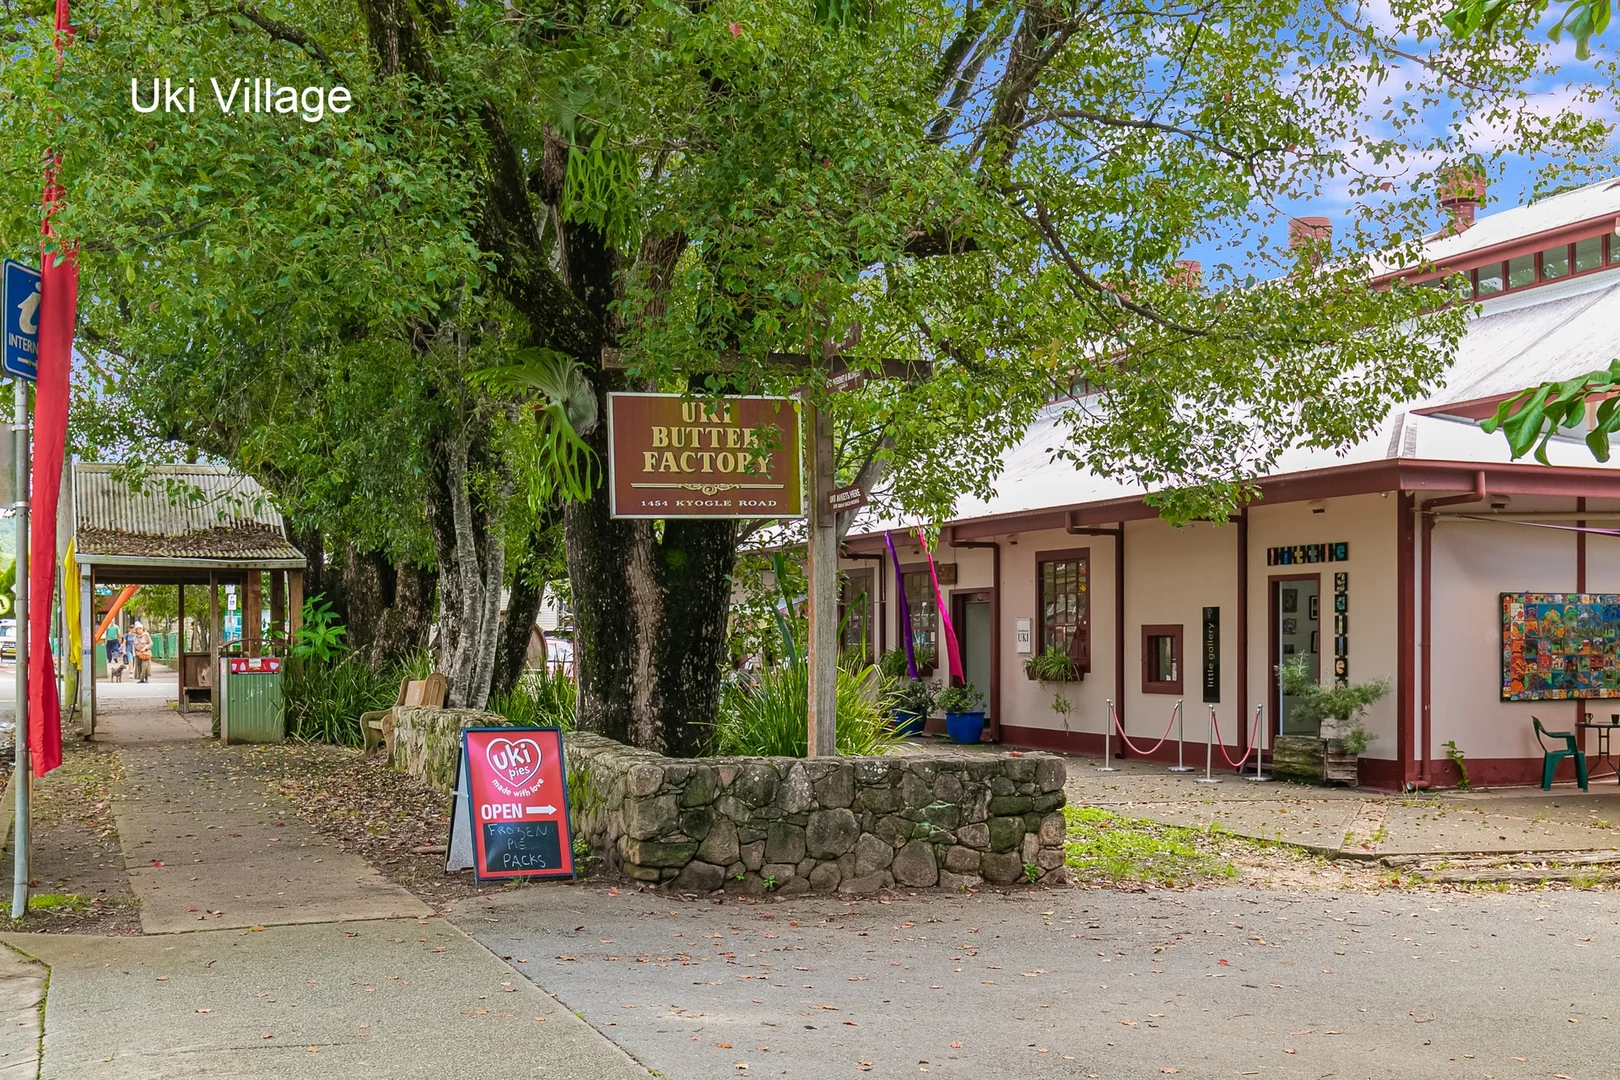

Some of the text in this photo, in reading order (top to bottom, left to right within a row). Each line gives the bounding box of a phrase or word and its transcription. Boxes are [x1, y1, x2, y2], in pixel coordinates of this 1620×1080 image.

[738, 500, 777, 508] ROAD
[1269, 543, 1346, 566] little
[1207, 622, 1215, 660] gallery
[508, 765, 530, 781] pies
[491, 777, 544, 798] made with love
[481, 804, 522, 820] OPEN
[487, 823, 547, 841] FROZEN
[507, 838, 526, 850] PIE
[503, 853, 546, 868] PACKS
